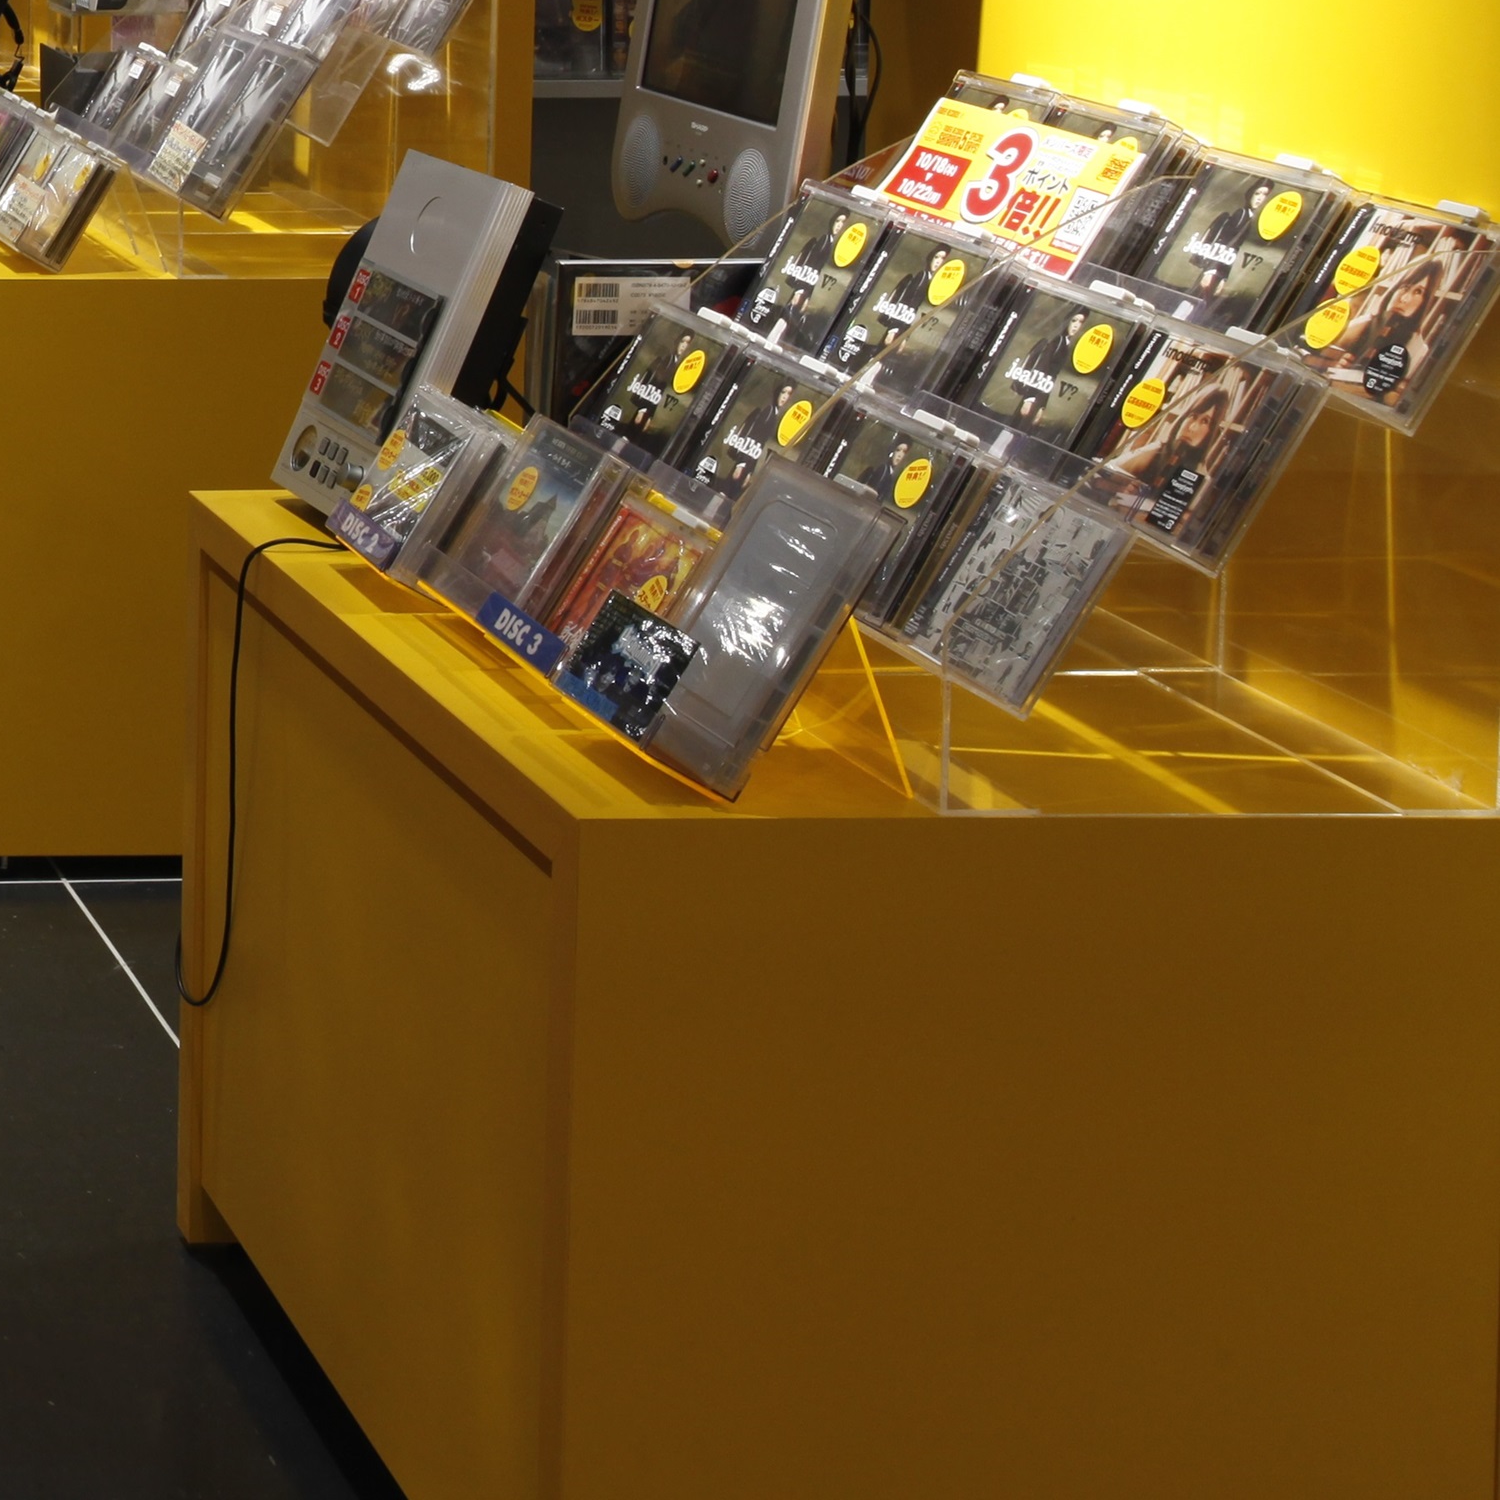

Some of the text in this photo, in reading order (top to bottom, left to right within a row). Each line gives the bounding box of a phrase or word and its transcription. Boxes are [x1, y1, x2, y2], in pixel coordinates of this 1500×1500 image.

[965, 131, 1033, 217] 3
[1021, 168, 1069, 195] ポイント
[999, 187, 1062, 240] 倍!!
[1183, 232, 1264, 272] jealkb V?
[780, 255, 838, 292] jealkb V?
[873, 292, 917, 324] jealkb
[626, 373, 679, 413] jealkb V?
[1004, 356, 1079, 402] jealkb V?
[723, 424, 763, 461] jealkb
[342, 514, 366, 545] DISC
[493, 607, 543, 656] DISC 3
